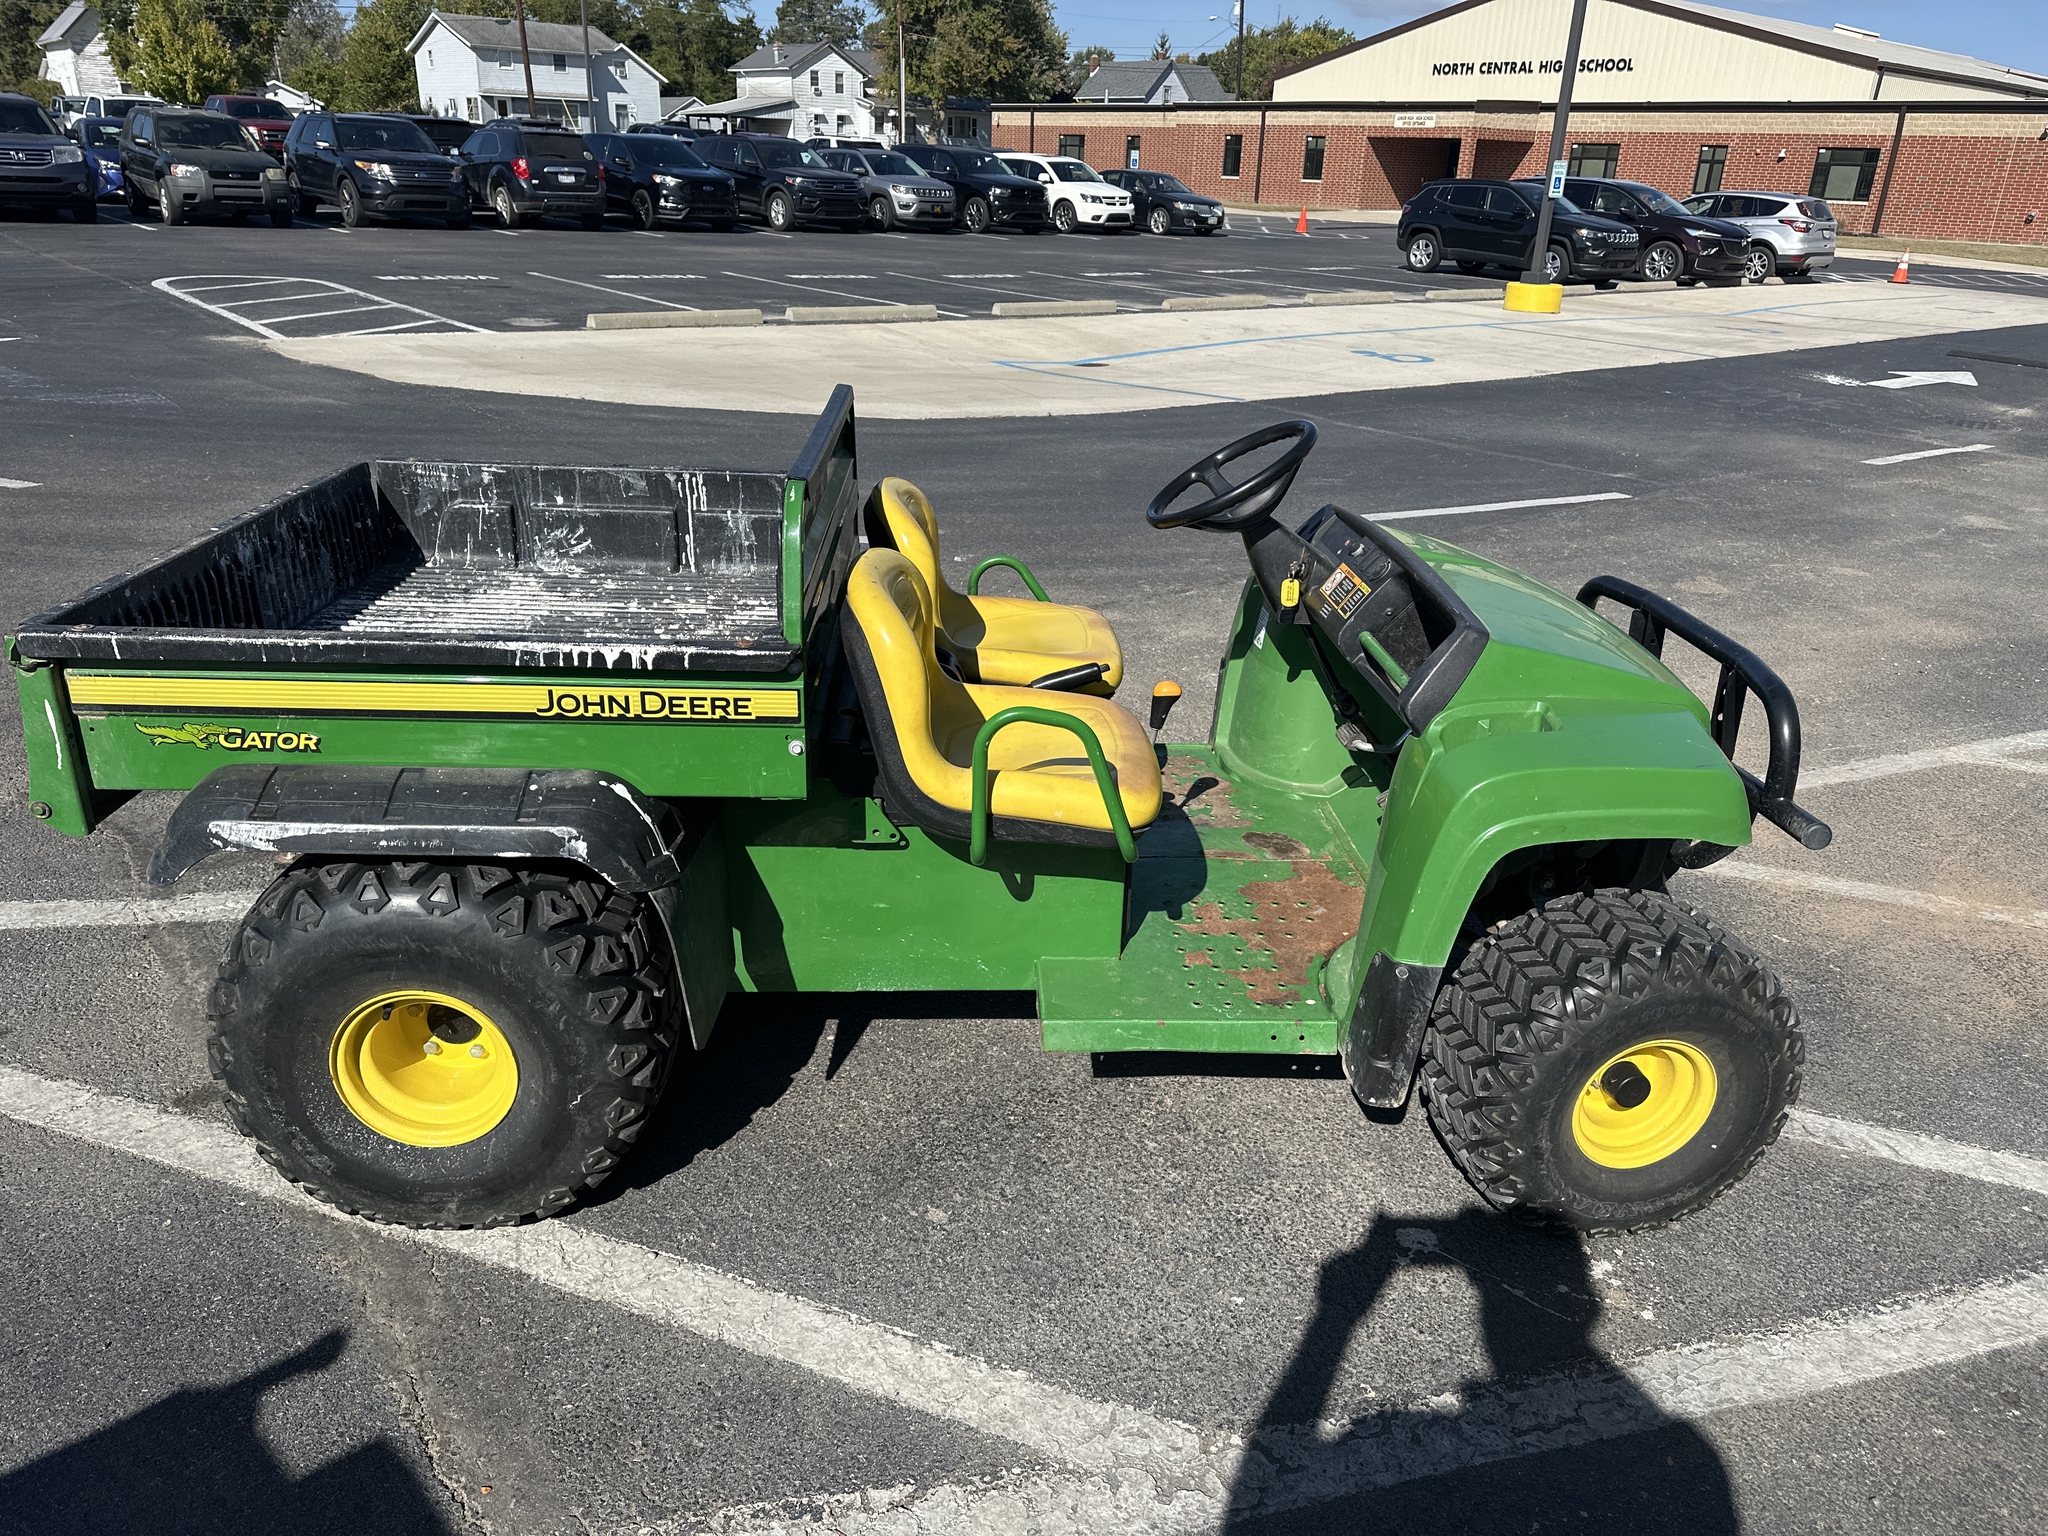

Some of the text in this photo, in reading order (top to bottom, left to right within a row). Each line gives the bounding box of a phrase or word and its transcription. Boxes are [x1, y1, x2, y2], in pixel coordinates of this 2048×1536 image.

[1432, 58, 1634, 76] NORTH CENTRAL HIG SCHOOL
[536, 689, 753, 717] JOHN DEERE
[217, 727, 321, 752] GATOR
